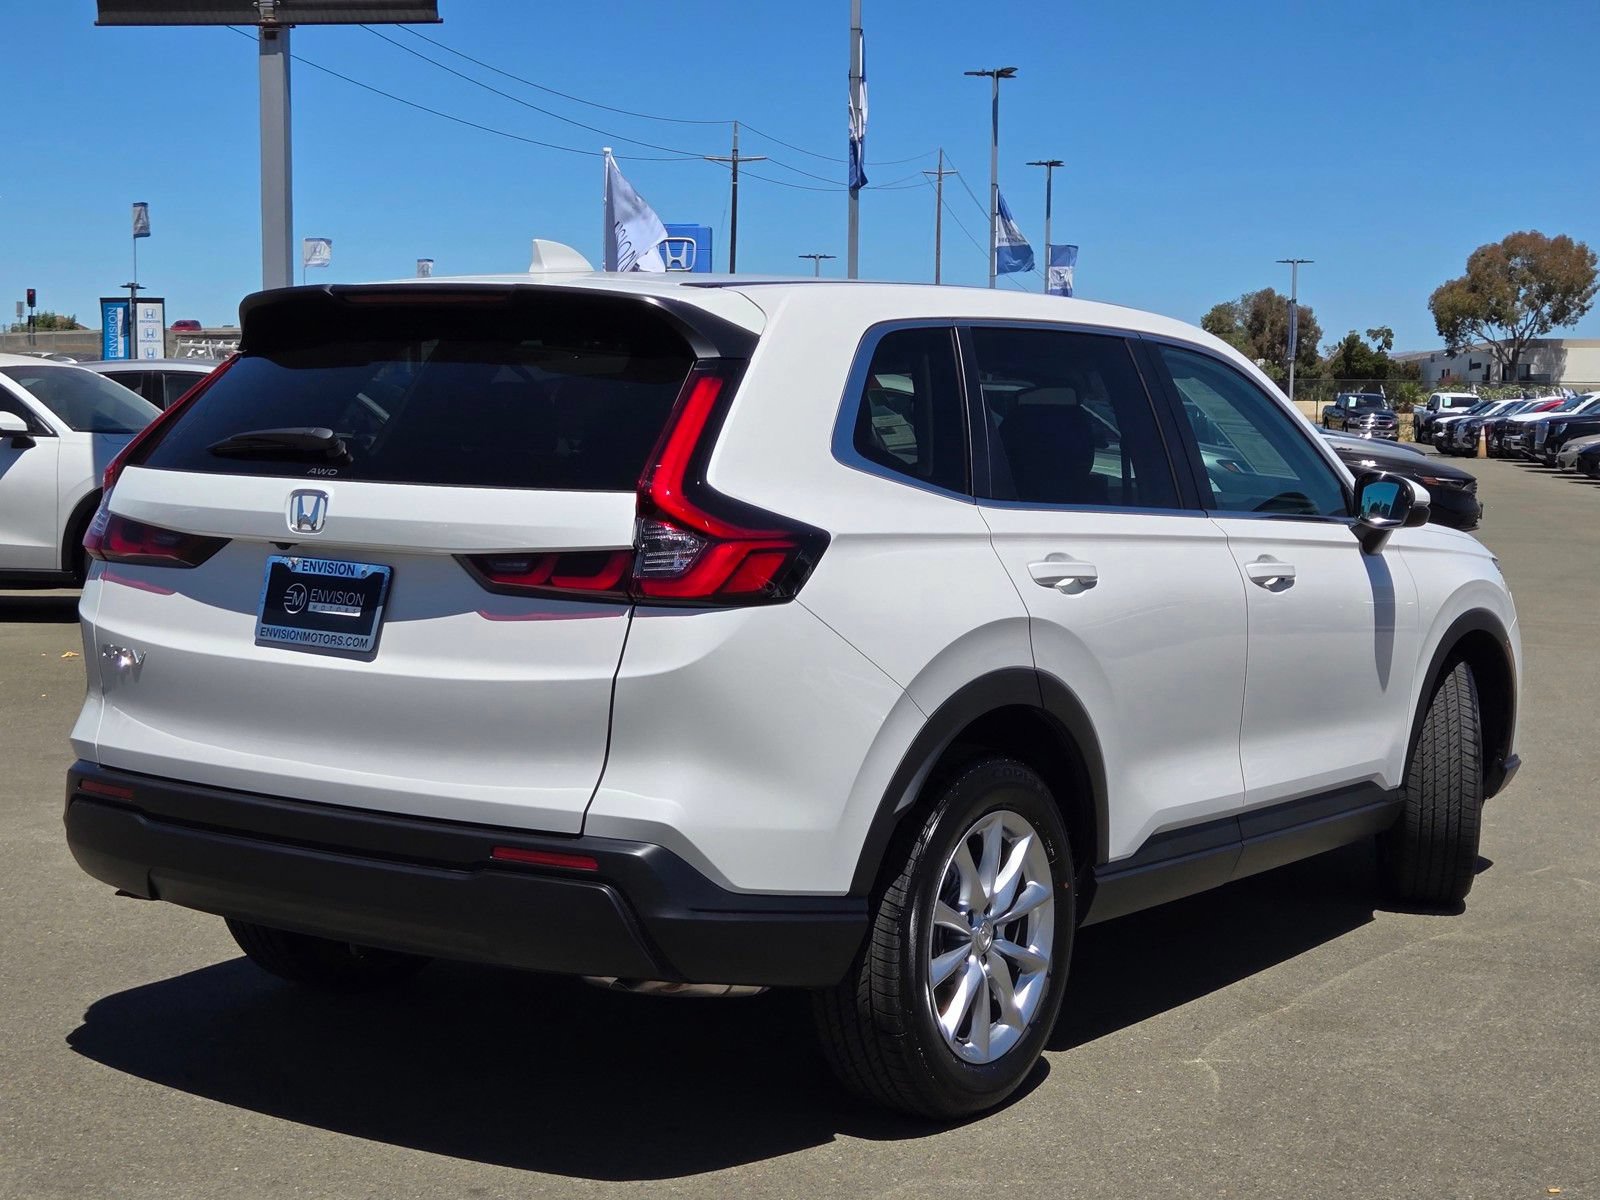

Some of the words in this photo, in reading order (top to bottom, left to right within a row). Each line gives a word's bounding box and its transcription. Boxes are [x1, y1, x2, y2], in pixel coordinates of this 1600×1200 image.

[108, 307, 118, 358] ENVISION
[307, 467, 338, 476] AWD
[301, 560, 356, 577] ENVISION
[309, 588, 366, 606] ENVISION
[260, 627, 369, 649] ENVISIONMOTORS.COM
